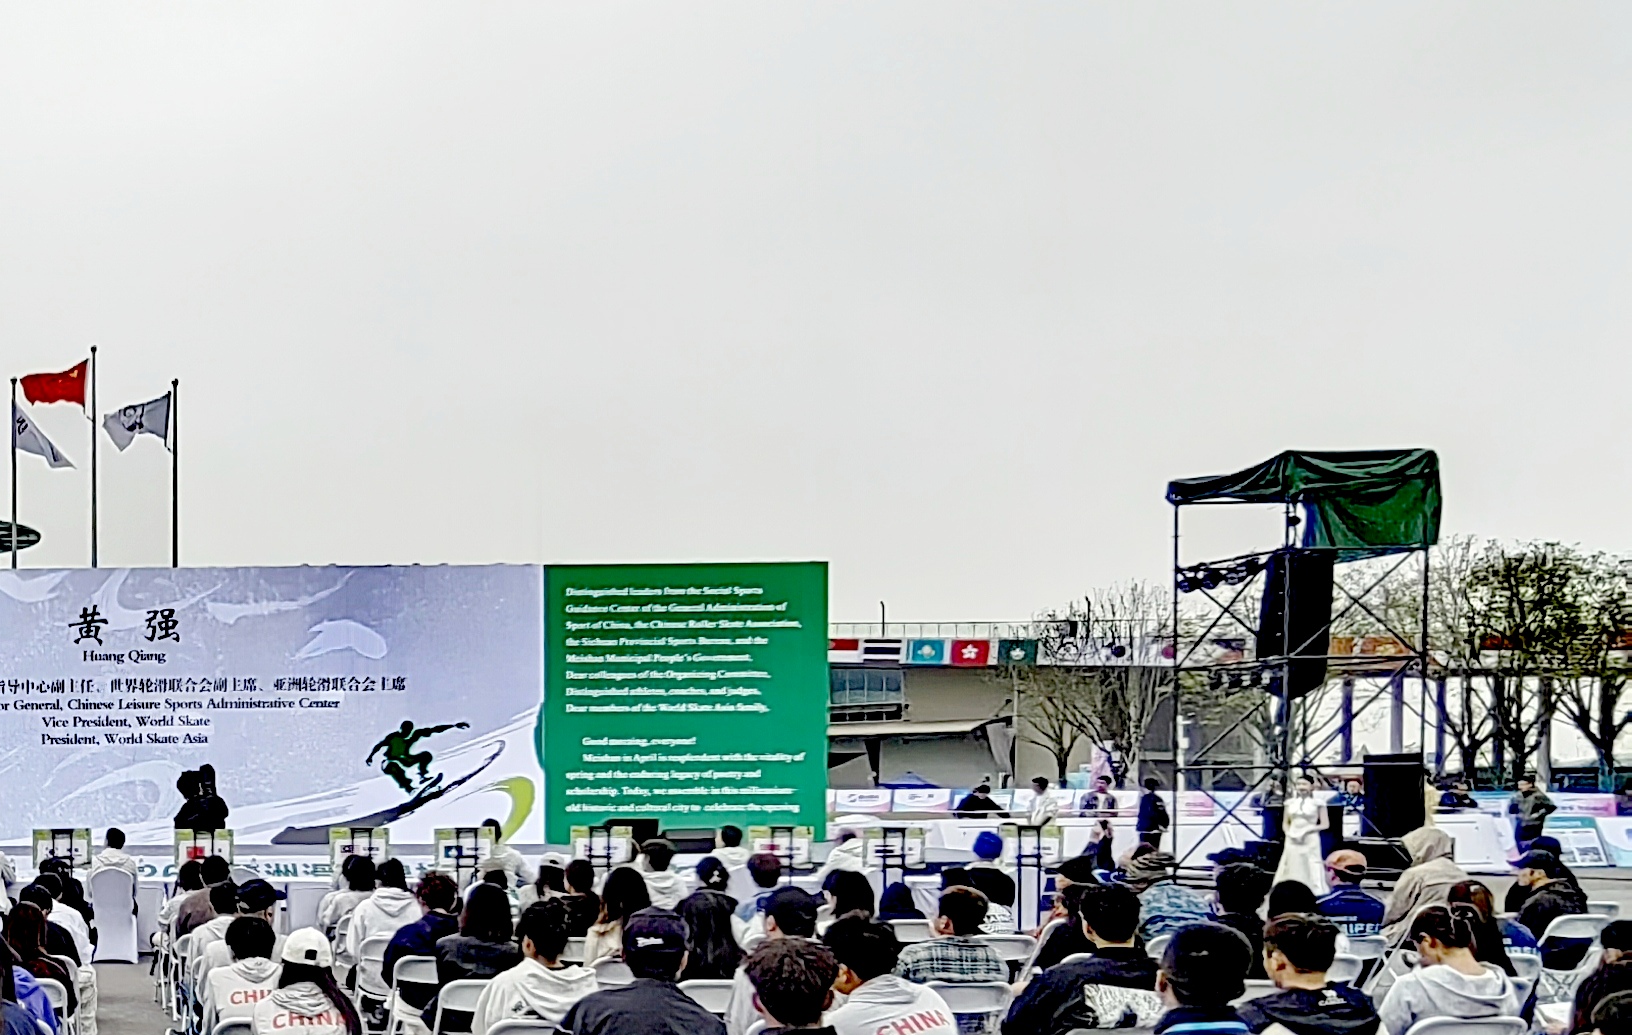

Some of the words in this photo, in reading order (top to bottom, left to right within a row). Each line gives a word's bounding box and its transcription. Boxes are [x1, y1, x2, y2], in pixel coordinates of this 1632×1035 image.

[69, 605, 108, 646] 黄
[145, 608, 180, 643] 强
[83, 650, 125, 664] Huang
[128, 650, 166, 664] Qiang
[13, 699, 64, 712] General,
[67, 699, 114, 711] Chinese
[118, 698, 161, 711] Leisure
[164, 698, 203, 711] Sports
[206, 698, 296, 710] Administrative
[298, 697, 341, 709] Center
[41, 717, 69, 728] Vice
[72, 716, 132, 729] President,
[136, 716, 174, 727] World
[177, 715, 211, 727] Skate
[41, 733, 100, 746] President,
[104, 733, 143, 745] World
[146, 733, 179, 745] Skate
[182, 733, 209, 744] Asia
